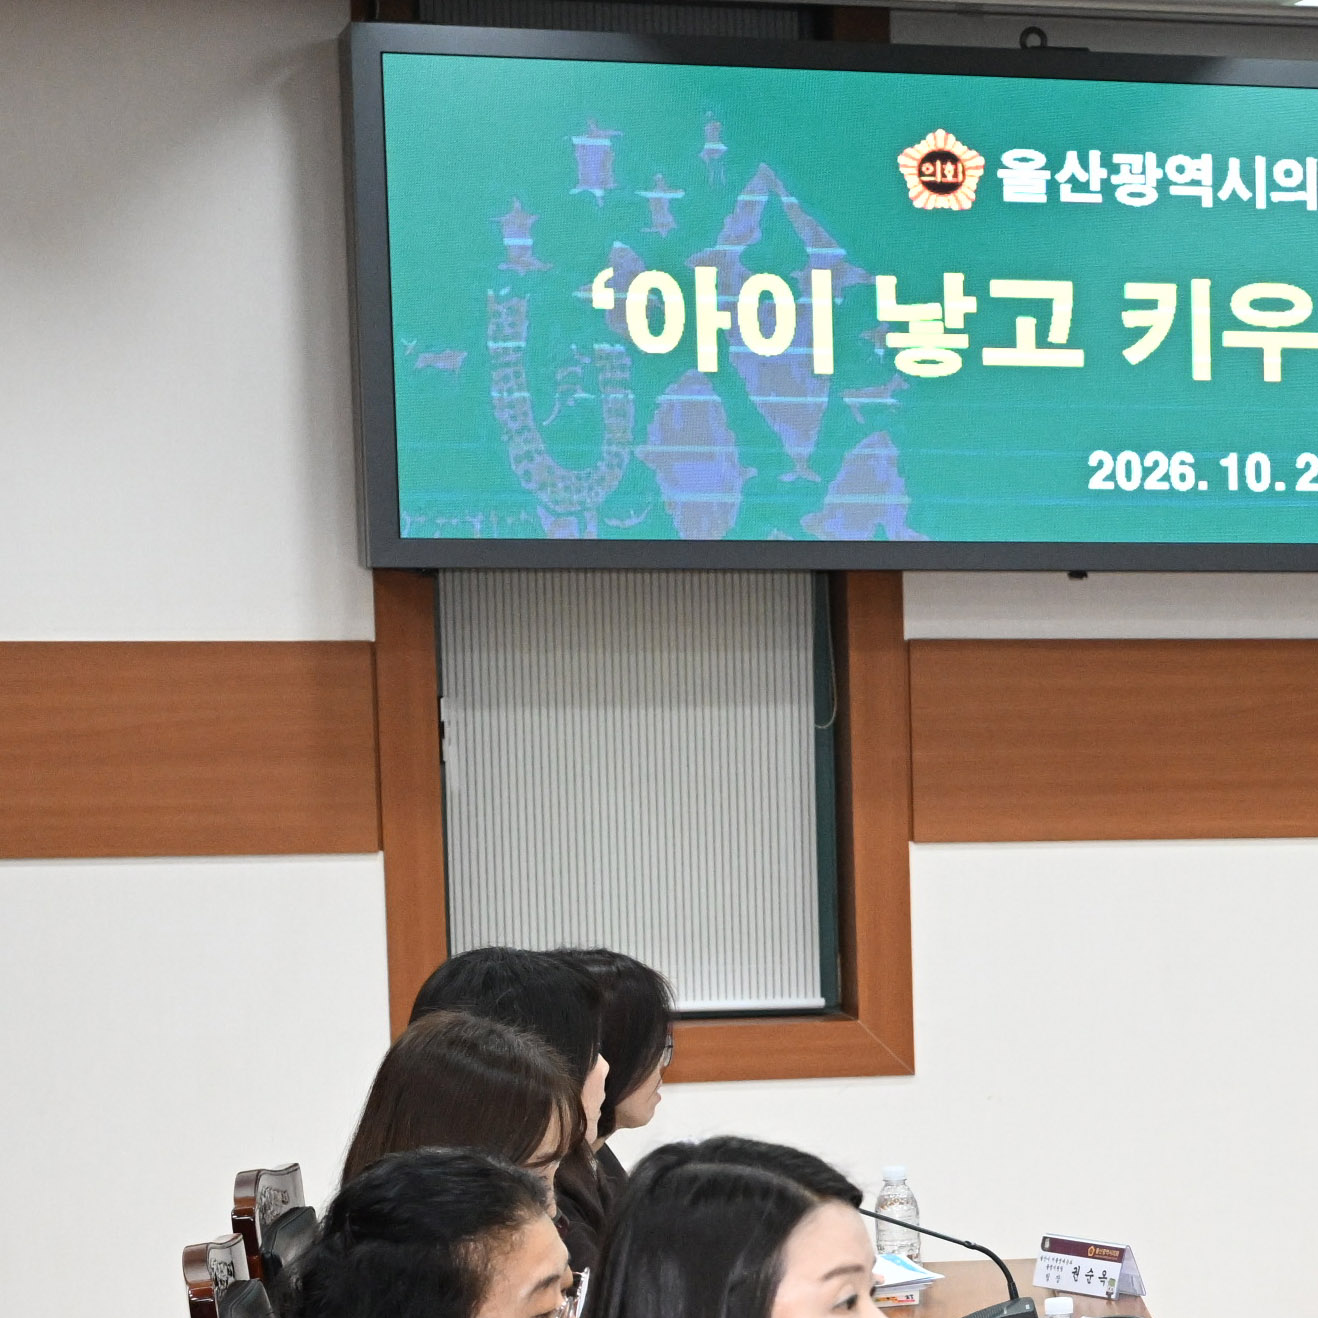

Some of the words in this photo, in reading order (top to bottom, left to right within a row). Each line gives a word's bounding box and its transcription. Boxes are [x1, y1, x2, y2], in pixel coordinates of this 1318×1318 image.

[920, 160, 964, 183] 의회
[875, 272, 1086, 379] 낳고
[1087, 449, 1209, 493] 2026.
[1219, 451, 1286, 494] 10.
